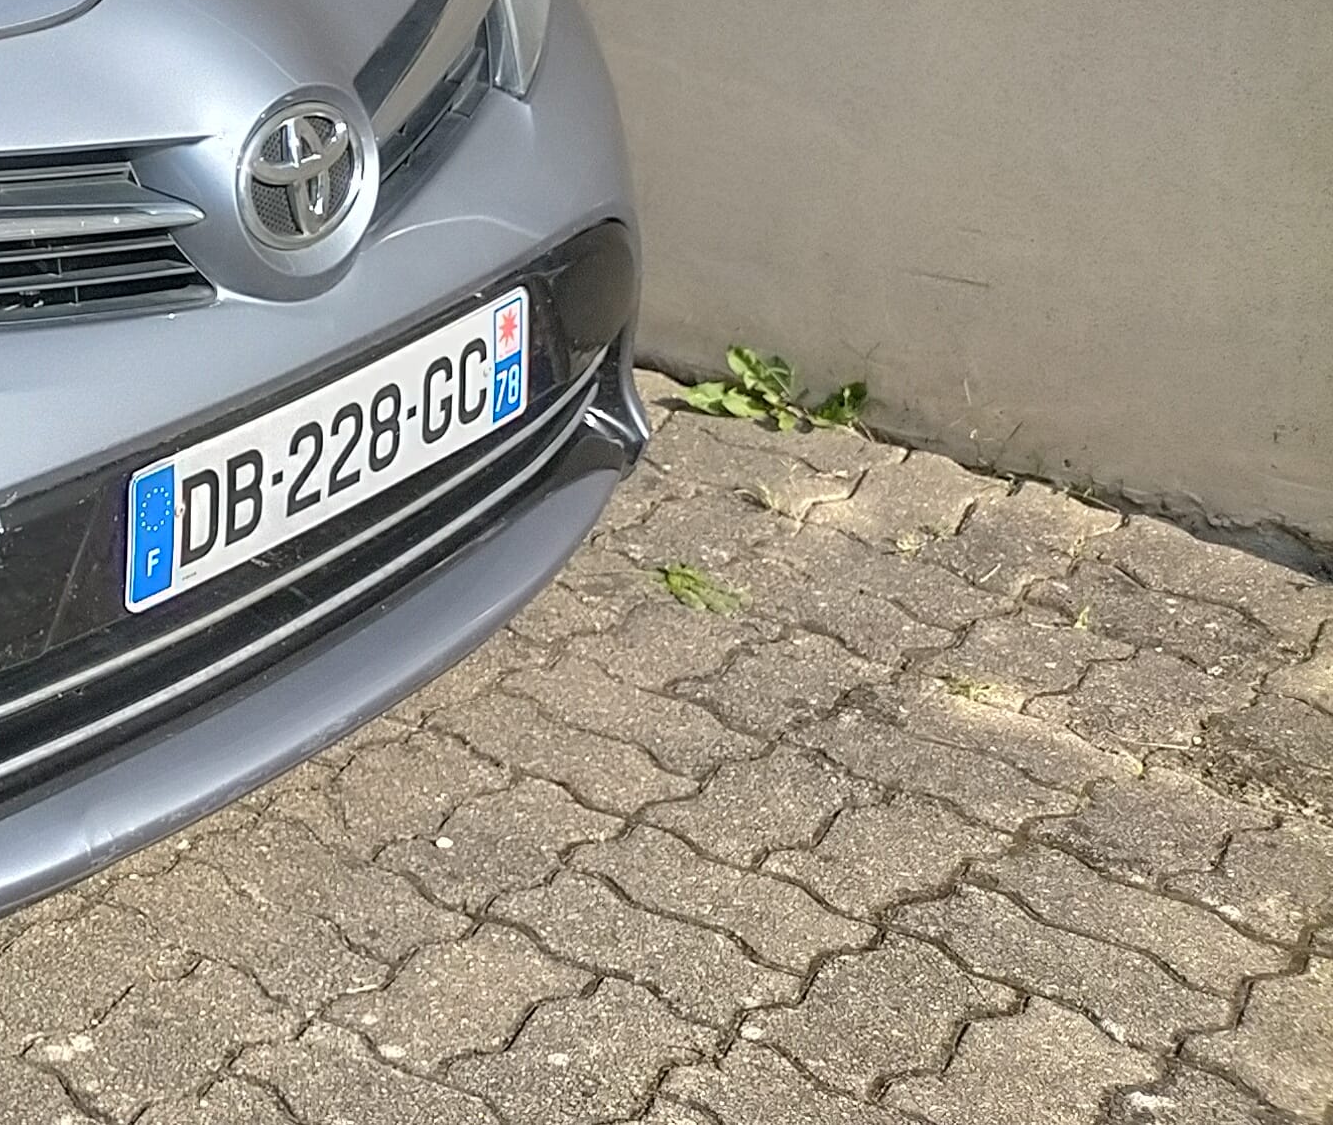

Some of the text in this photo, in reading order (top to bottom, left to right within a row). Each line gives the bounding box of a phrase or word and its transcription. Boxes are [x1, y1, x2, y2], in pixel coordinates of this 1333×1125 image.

[495, 363, 520, 412] 78
[180, 337, 487, 568] DB-228-GC
[147, 547, 161, 577] F
